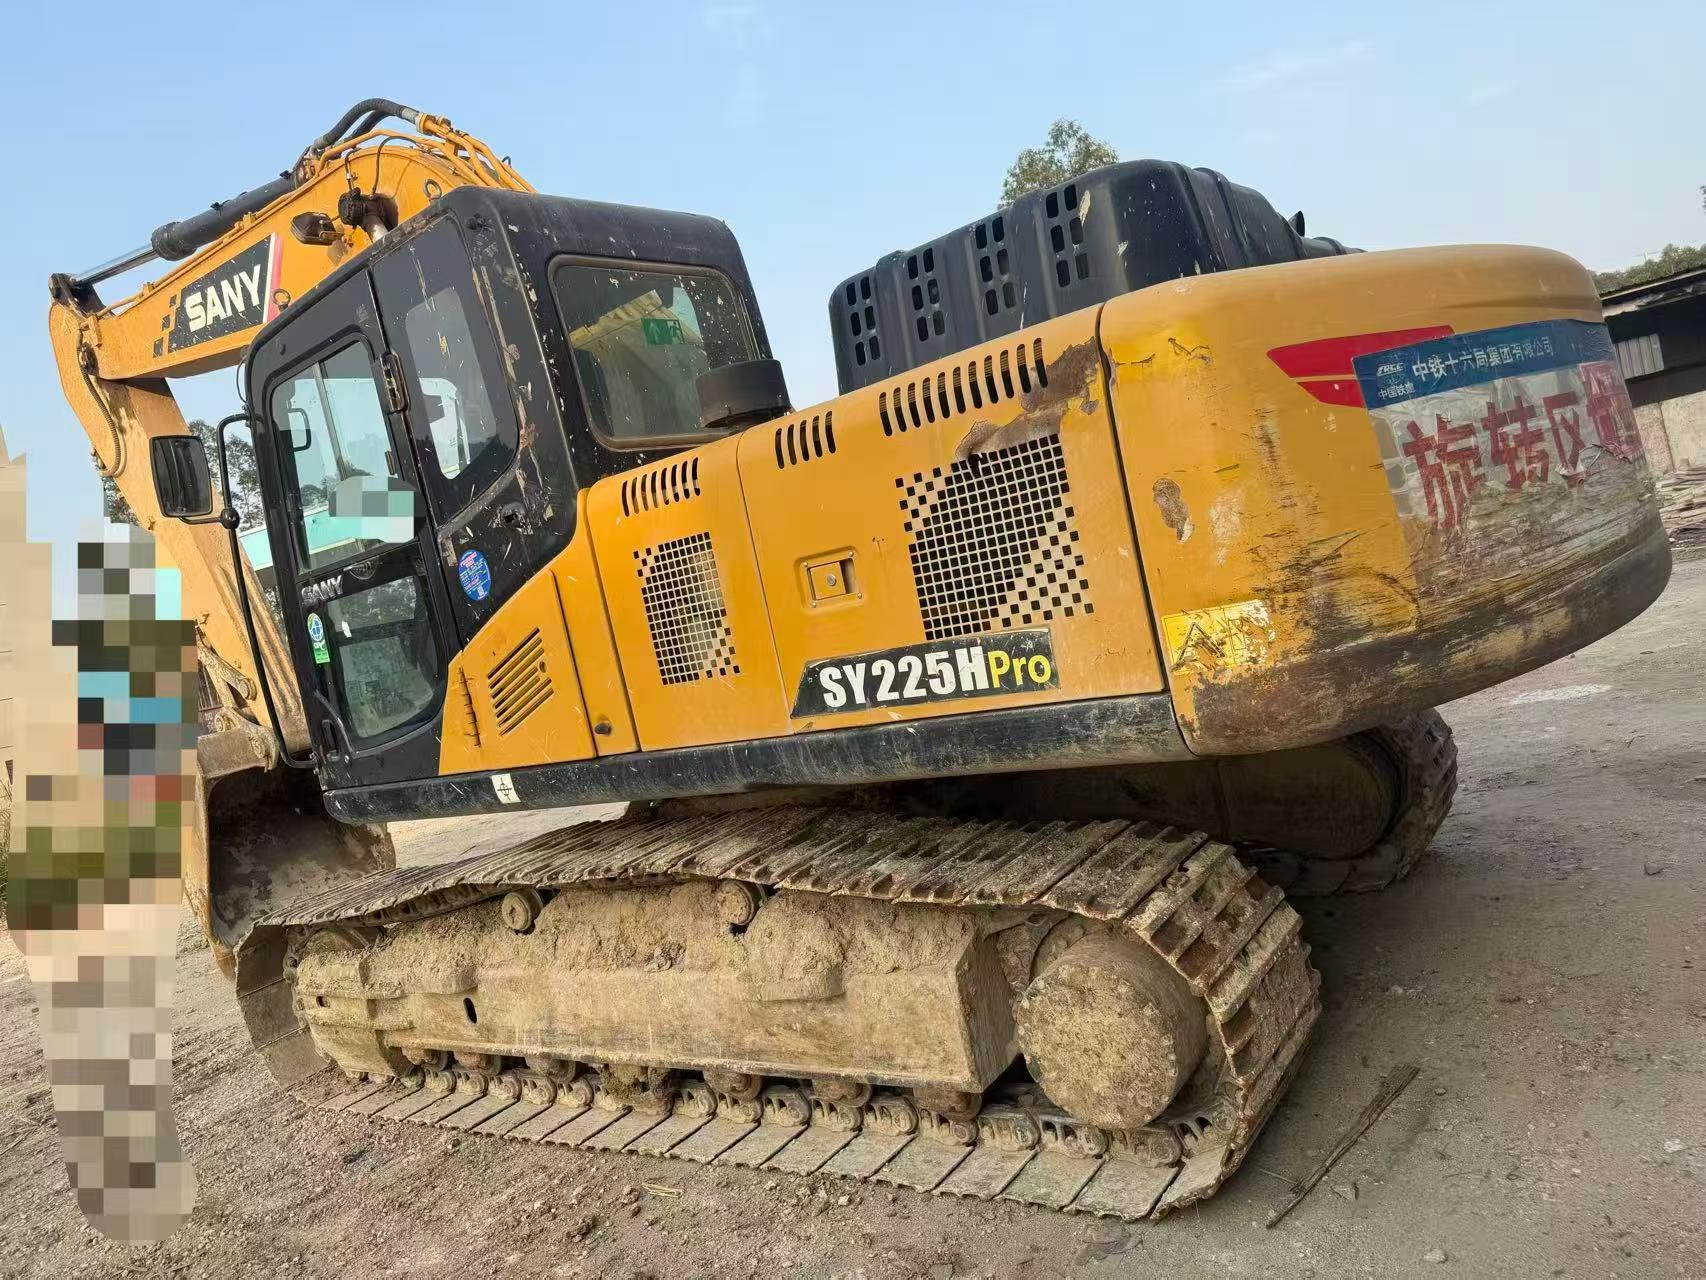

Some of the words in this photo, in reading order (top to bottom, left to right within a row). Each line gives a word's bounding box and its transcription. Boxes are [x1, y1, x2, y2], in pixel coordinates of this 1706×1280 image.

[185, 264, 261, 332] SANY
[1412, 336, 1554, 382] 中铁十六局集团有限公司
[301, 575, 343, 607] SANY
